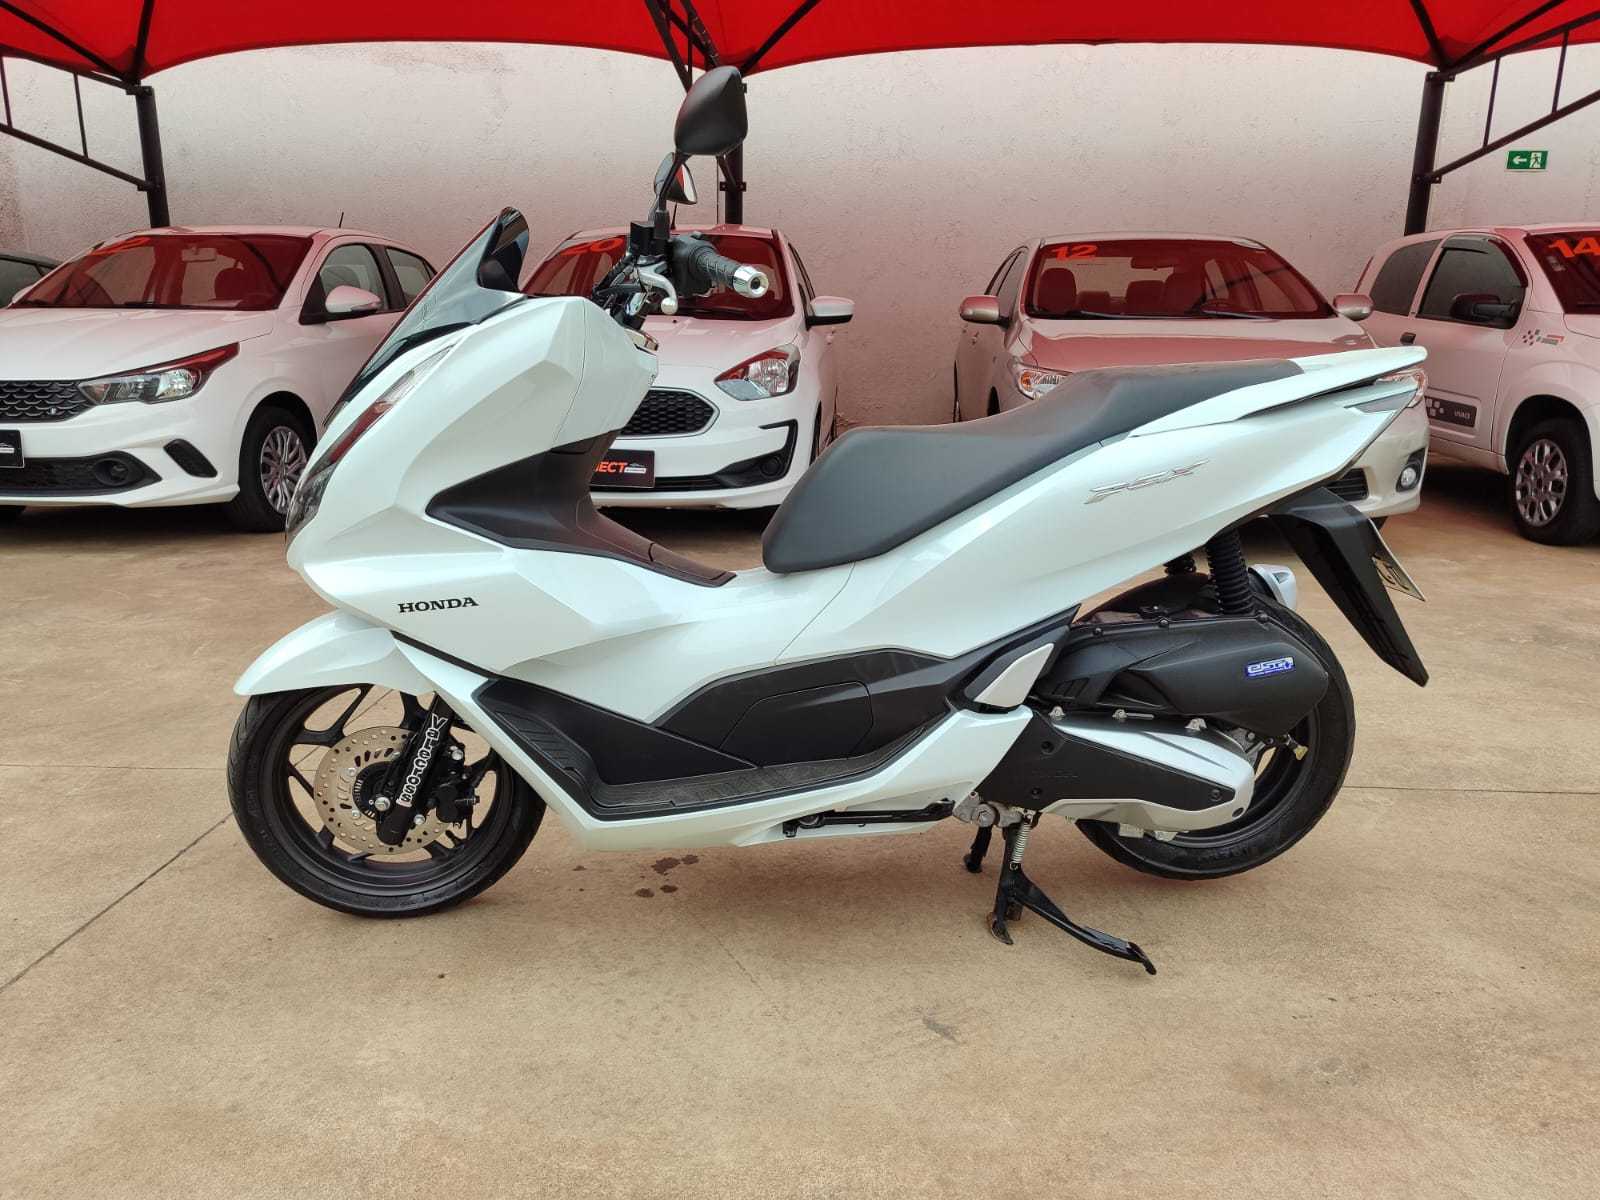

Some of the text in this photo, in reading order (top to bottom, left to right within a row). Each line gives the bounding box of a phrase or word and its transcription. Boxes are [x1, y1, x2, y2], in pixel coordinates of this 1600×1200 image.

[1051, 244, 1098, 261] 12
[1548, 236, 1600, 258] 14
[398, 596, 480, 613] HONDA
